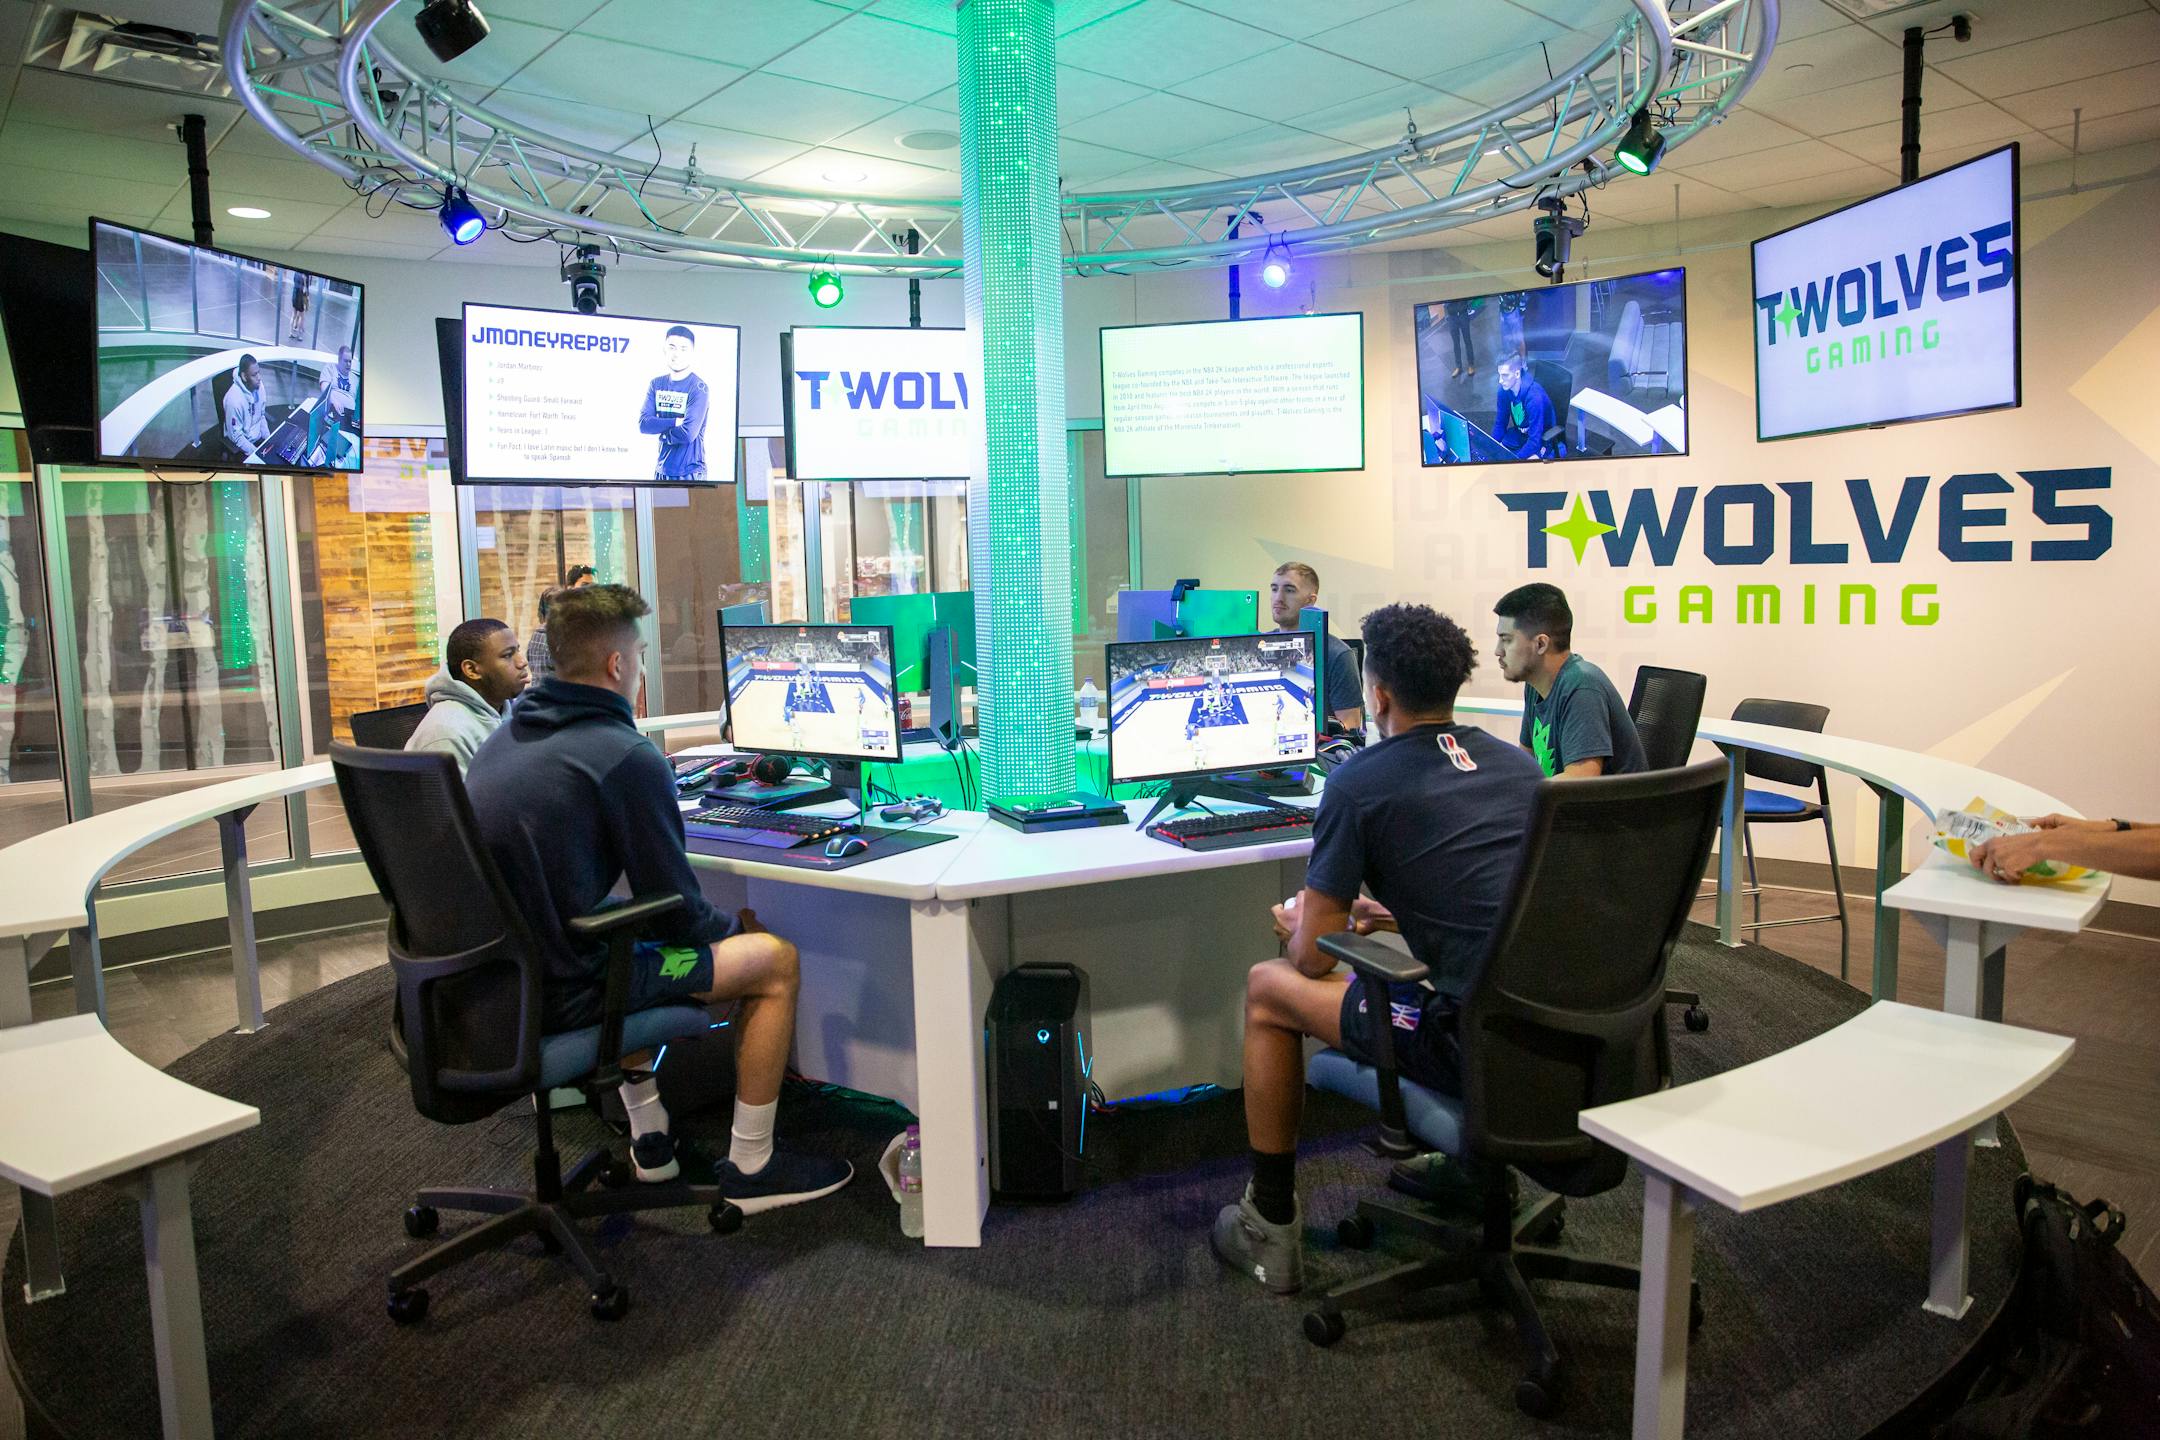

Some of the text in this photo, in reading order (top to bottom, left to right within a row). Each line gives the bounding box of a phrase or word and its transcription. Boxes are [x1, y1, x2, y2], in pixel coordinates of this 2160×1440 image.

[472, 326, 630, 353] JMONEYREP817
[1807, 319, 1940, 374] GAMING
[1624, 583, 1940, 626] GAMING
